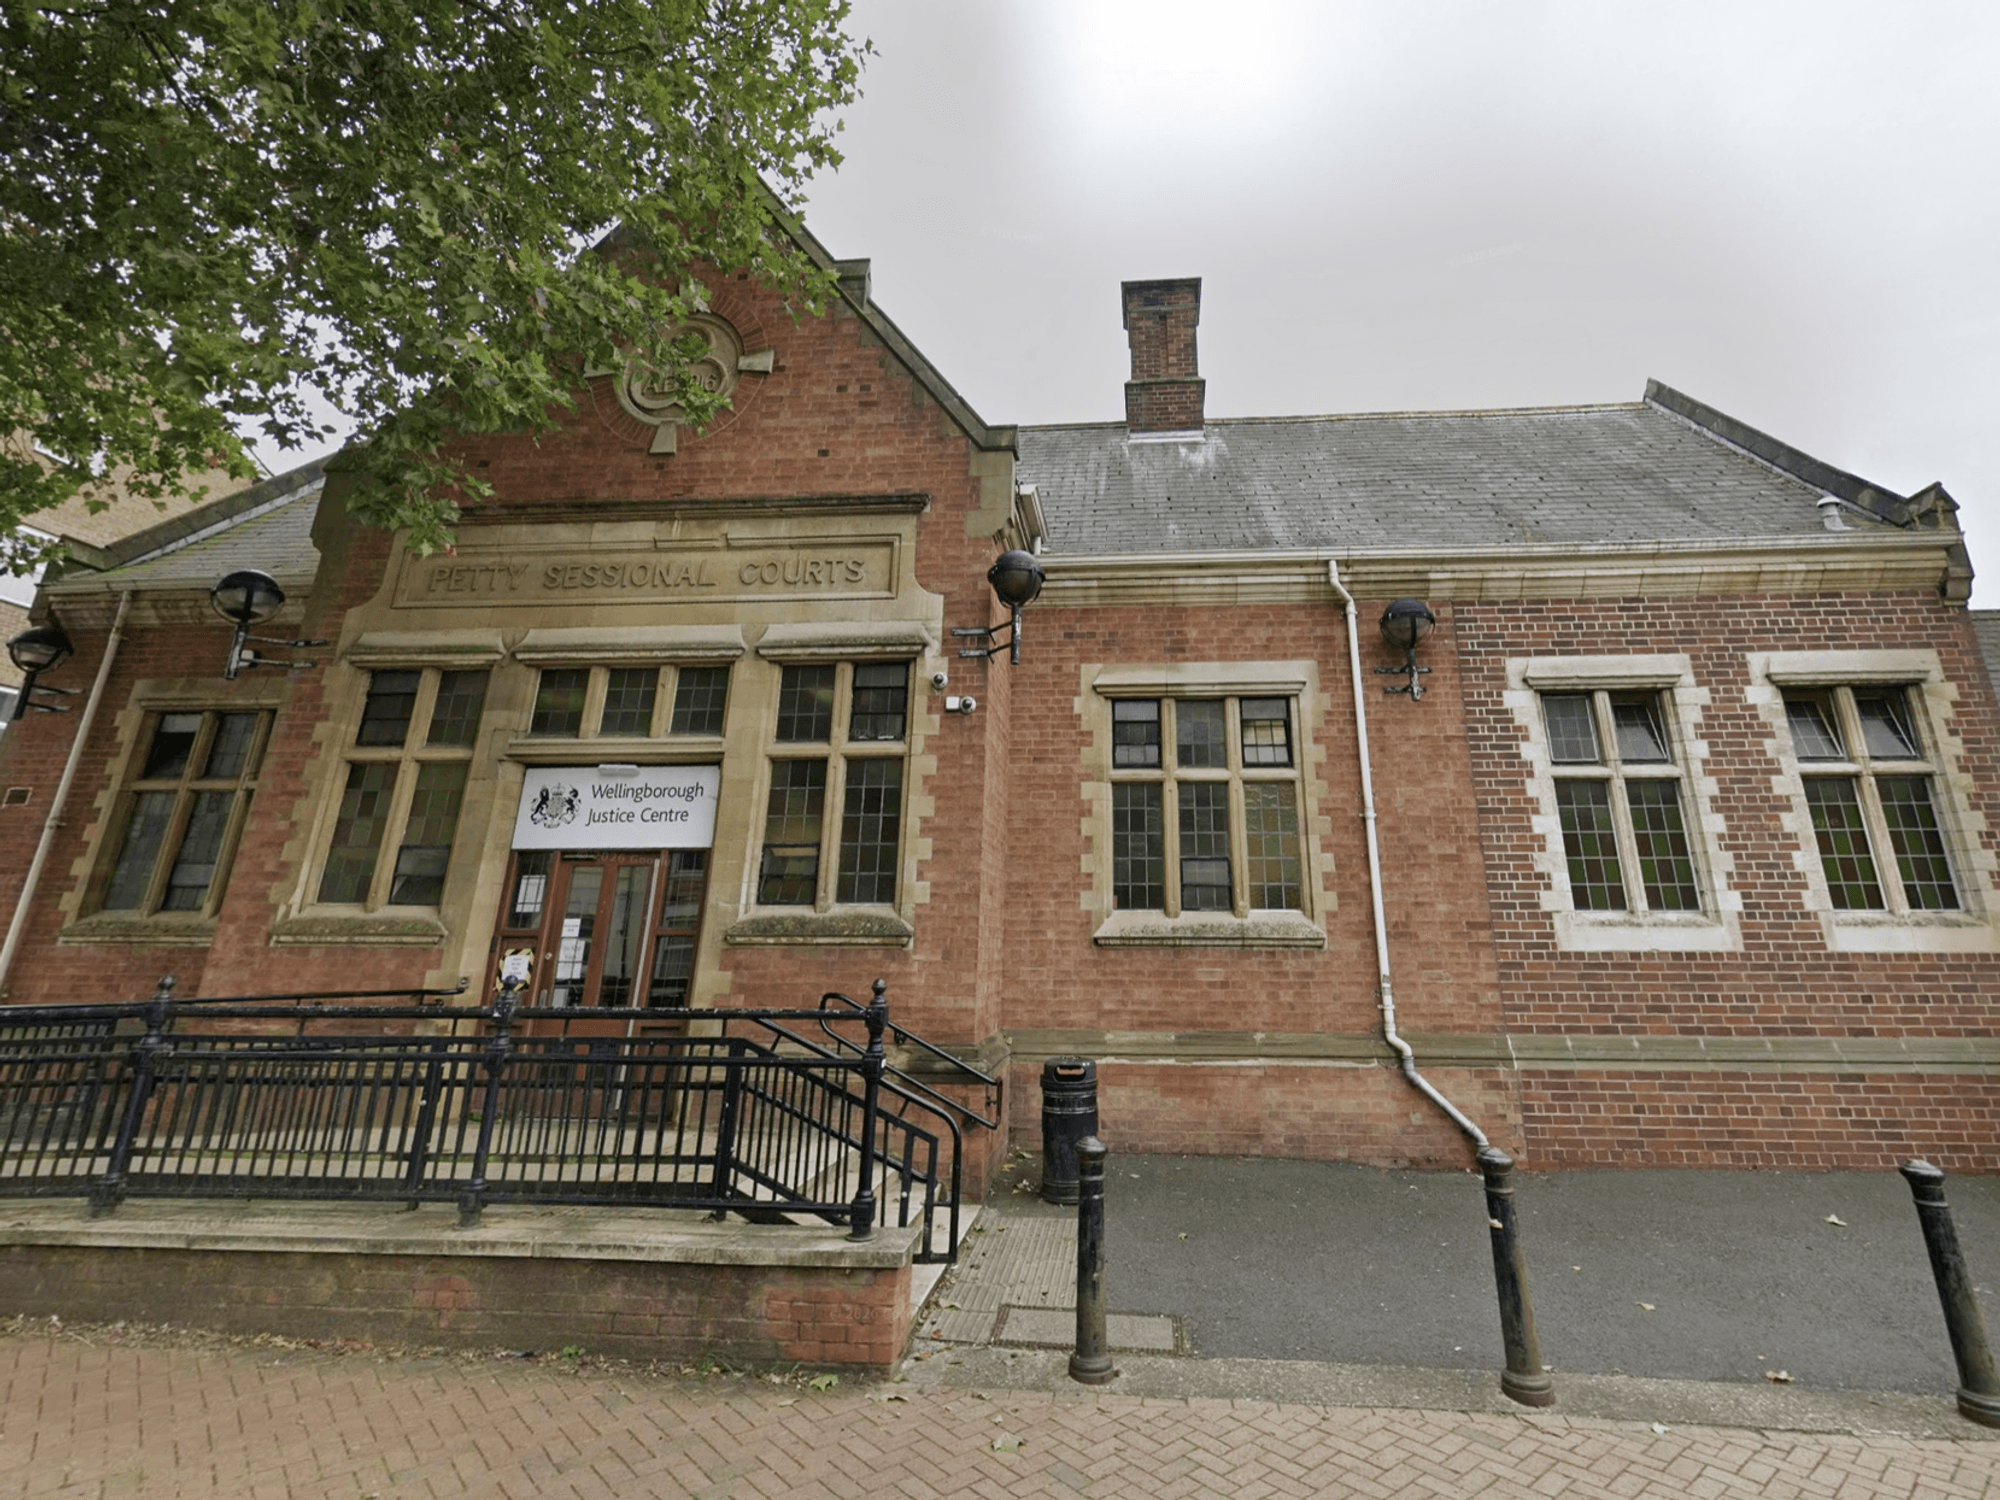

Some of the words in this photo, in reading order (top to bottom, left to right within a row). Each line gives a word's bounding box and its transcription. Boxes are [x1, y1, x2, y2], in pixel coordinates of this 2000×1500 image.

[430, 562, 528, 593] PETTY
[544, 561, 717, 590] SESSIONAL
[739, 558, 866, 586] COURTS
[591, 782, 704, 803] Wellingborough
[586, 807, 635, 826] Justice
[640, 806, 689, 824] Centre
